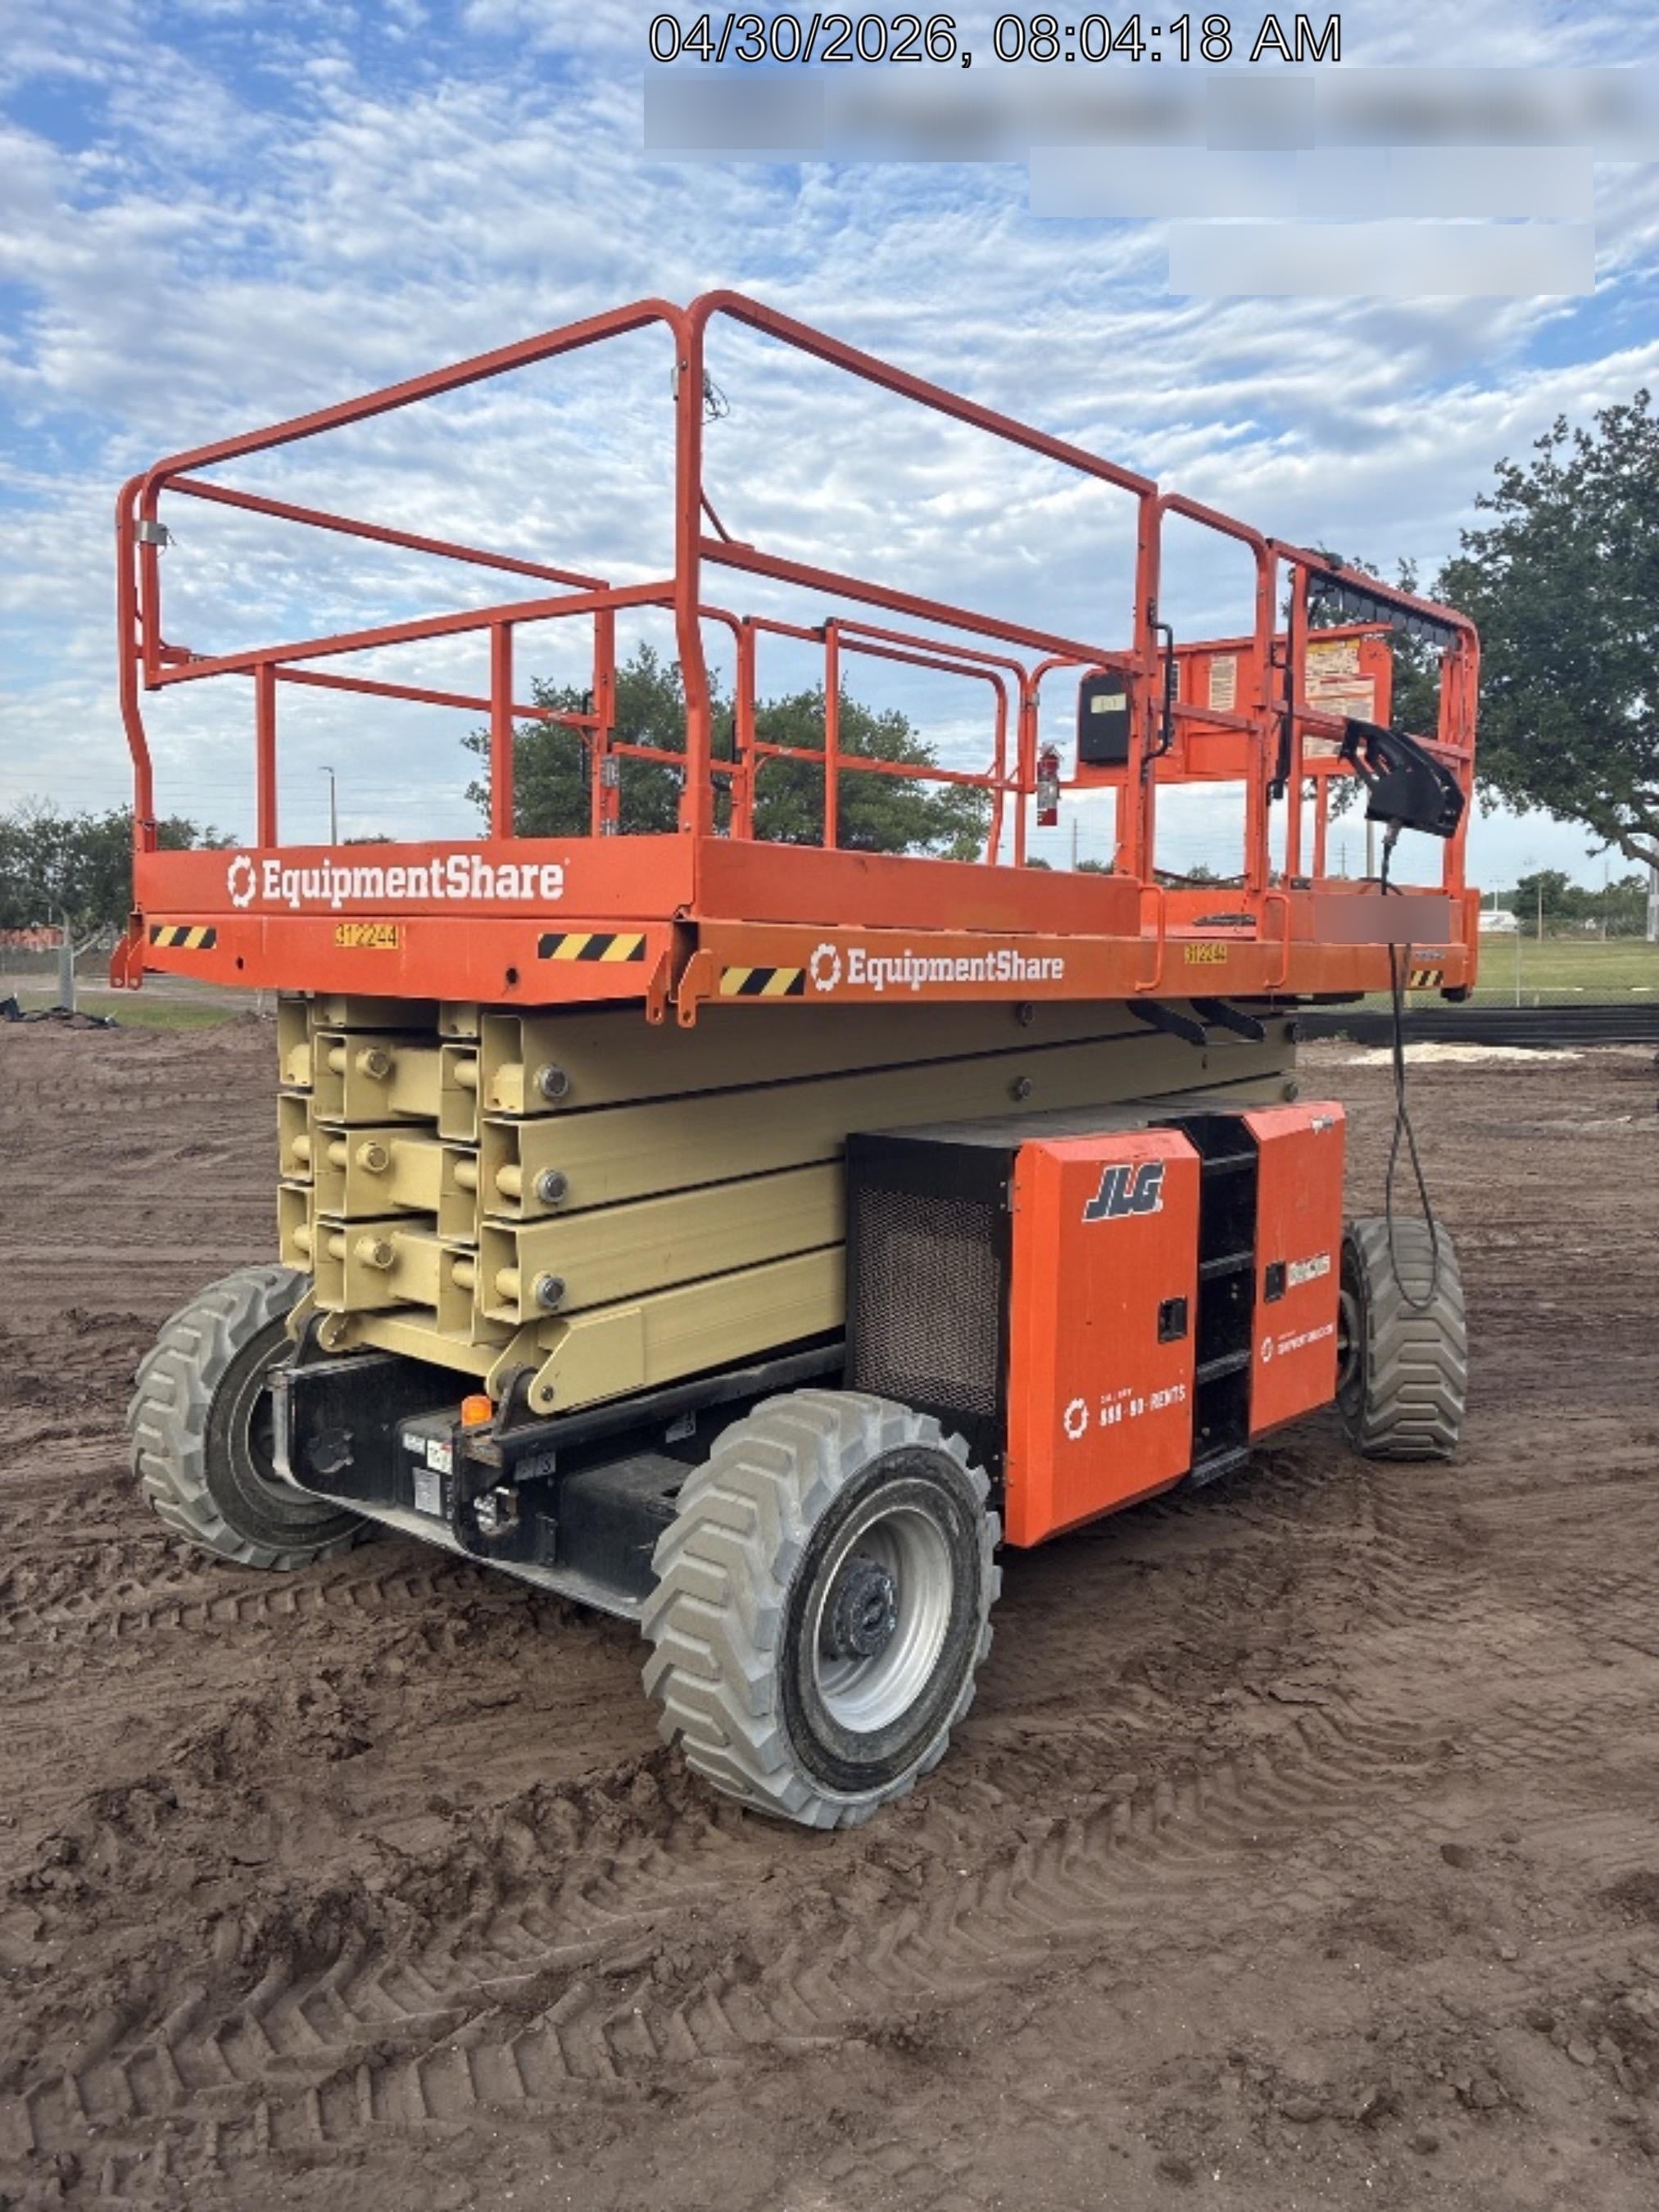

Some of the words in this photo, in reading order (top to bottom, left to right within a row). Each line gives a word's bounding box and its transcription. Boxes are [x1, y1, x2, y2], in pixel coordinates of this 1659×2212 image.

[261, 854, 564, 909] EquipmentShare
[847, 948, 1064, 991] EquipmentShare
[1081, 1160, 1166, 1223] JLG
